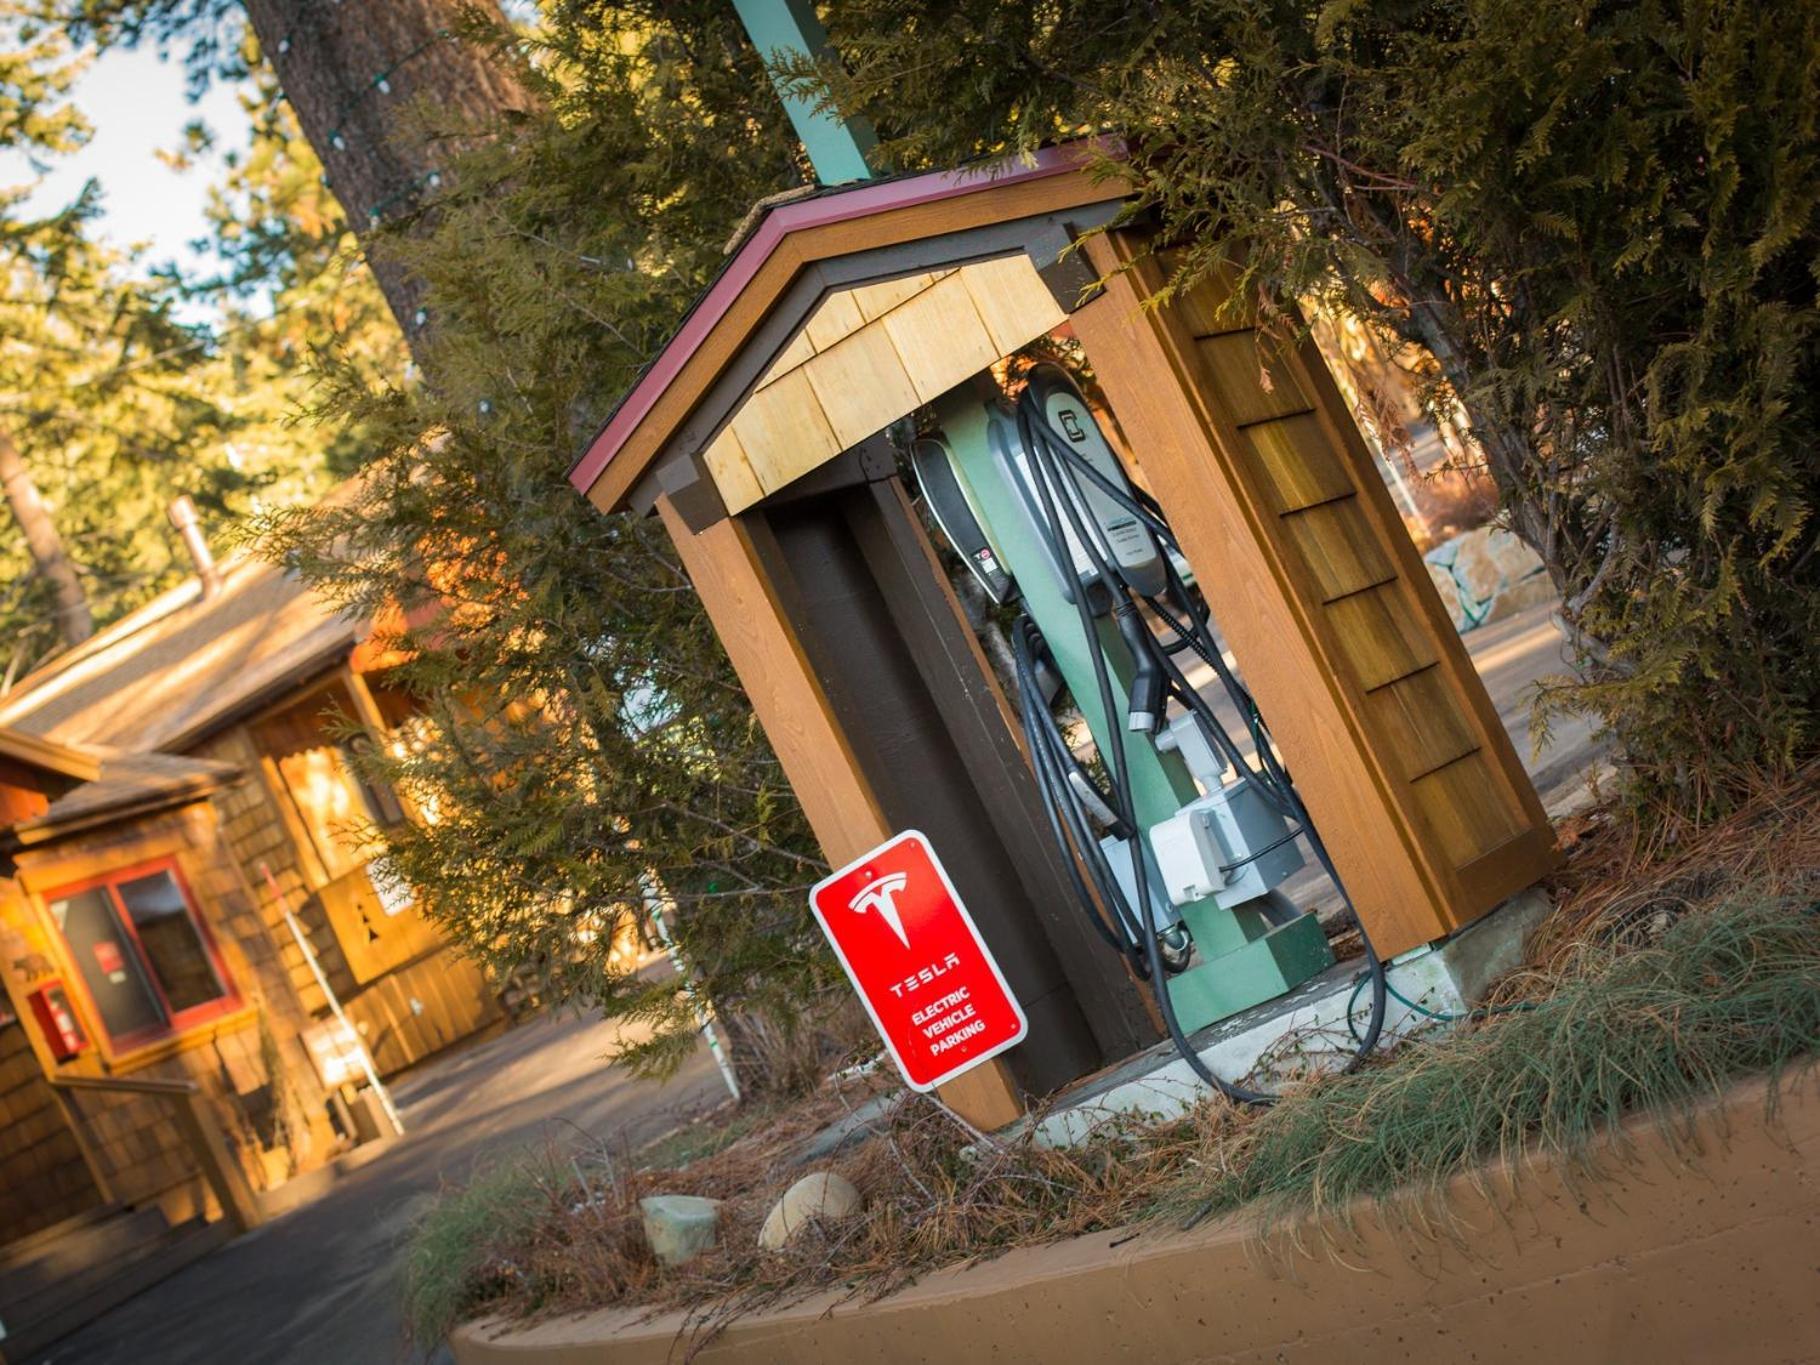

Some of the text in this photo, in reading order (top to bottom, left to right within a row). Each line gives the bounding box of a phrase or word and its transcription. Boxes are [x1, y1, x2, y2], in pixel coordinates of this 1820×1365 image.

[889, 952, 960, 998] TESLA
[911, 986, 970, 1026] ELECTRIC
[922, 1003, 976, 1039] VEHICLE
[929, 1020, 986, 1056] PARKING
